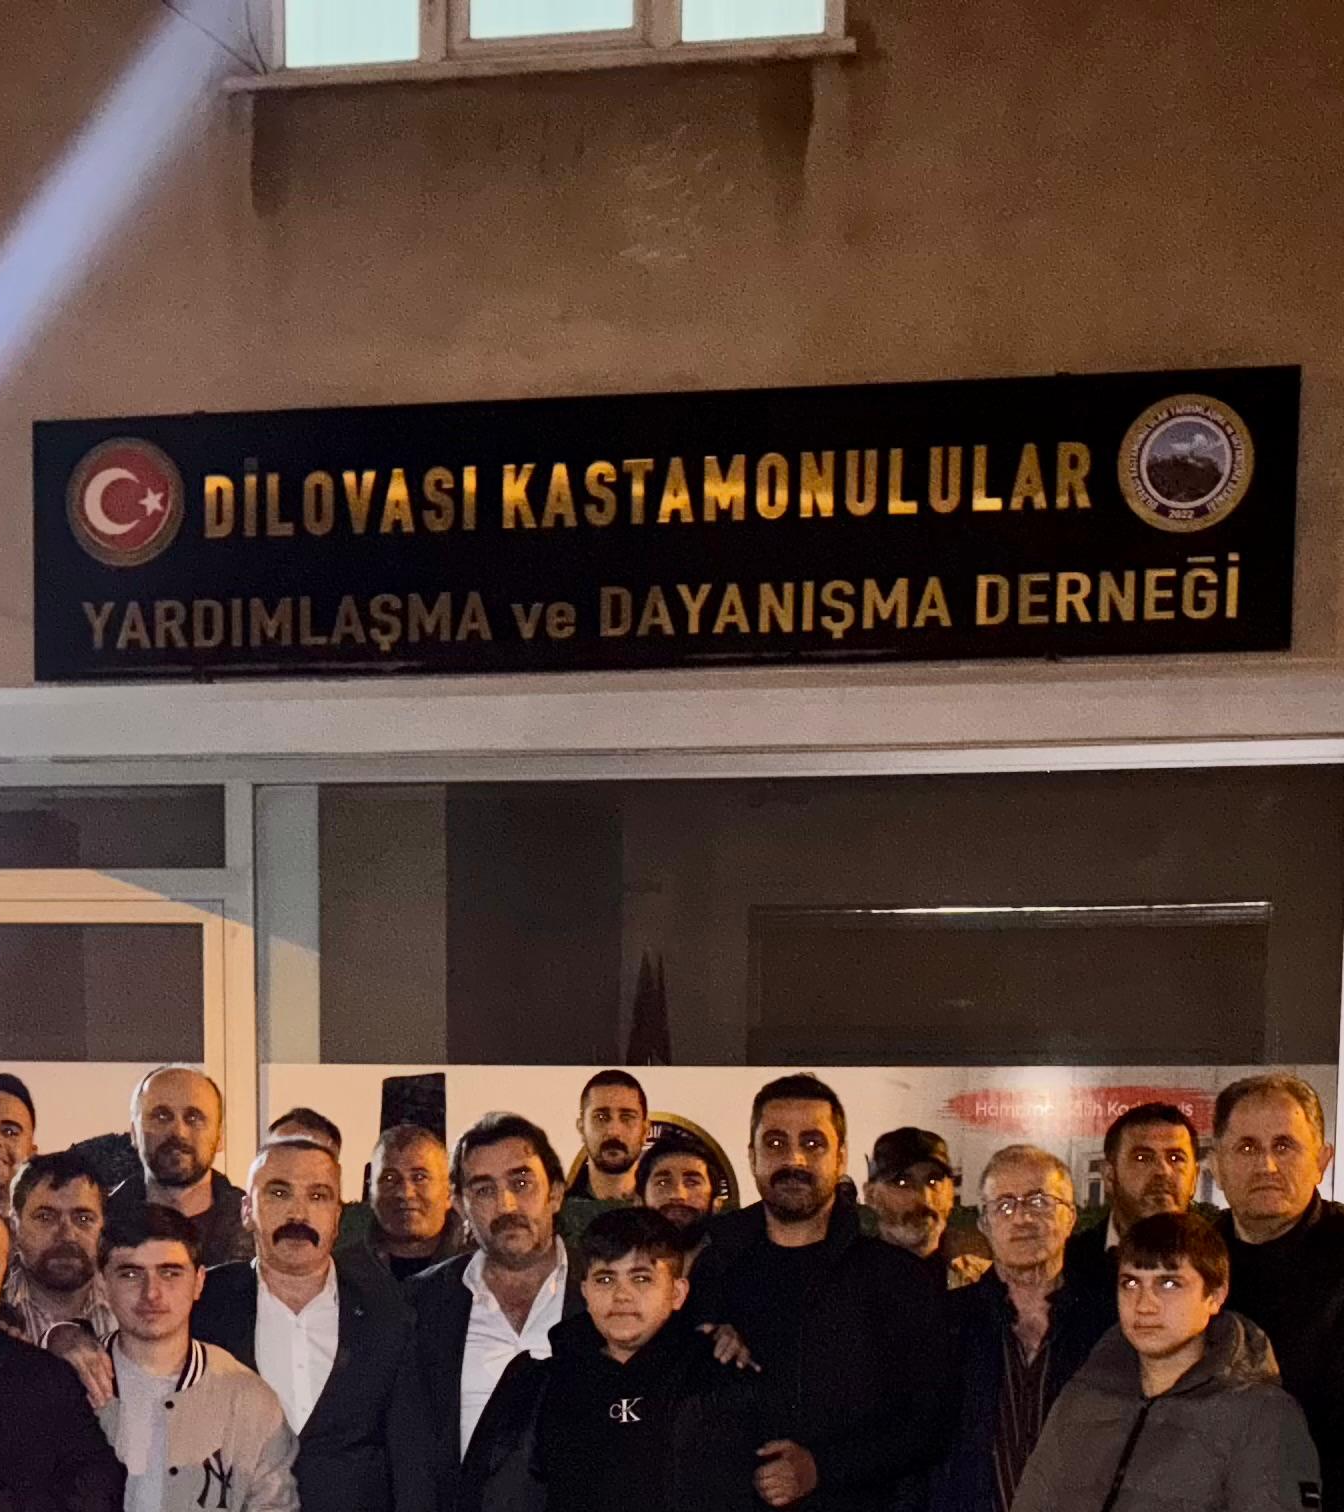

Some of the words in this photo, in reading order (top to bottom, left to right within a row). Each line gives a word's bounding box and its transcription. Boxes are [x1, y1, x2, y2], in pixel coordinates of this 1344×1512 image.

[204, 456, 477, 538] DİLOVASI
[501, 440, 1093, 529] KASTAMONULULAR
[81, 591, 493, 652] YARDIMLAŞMA
[510, 600, 577, 639] ve
[599, 574, 953, 640] DAYANIŞMA
[975, 552, 1240, 627] DERNEĞİ
